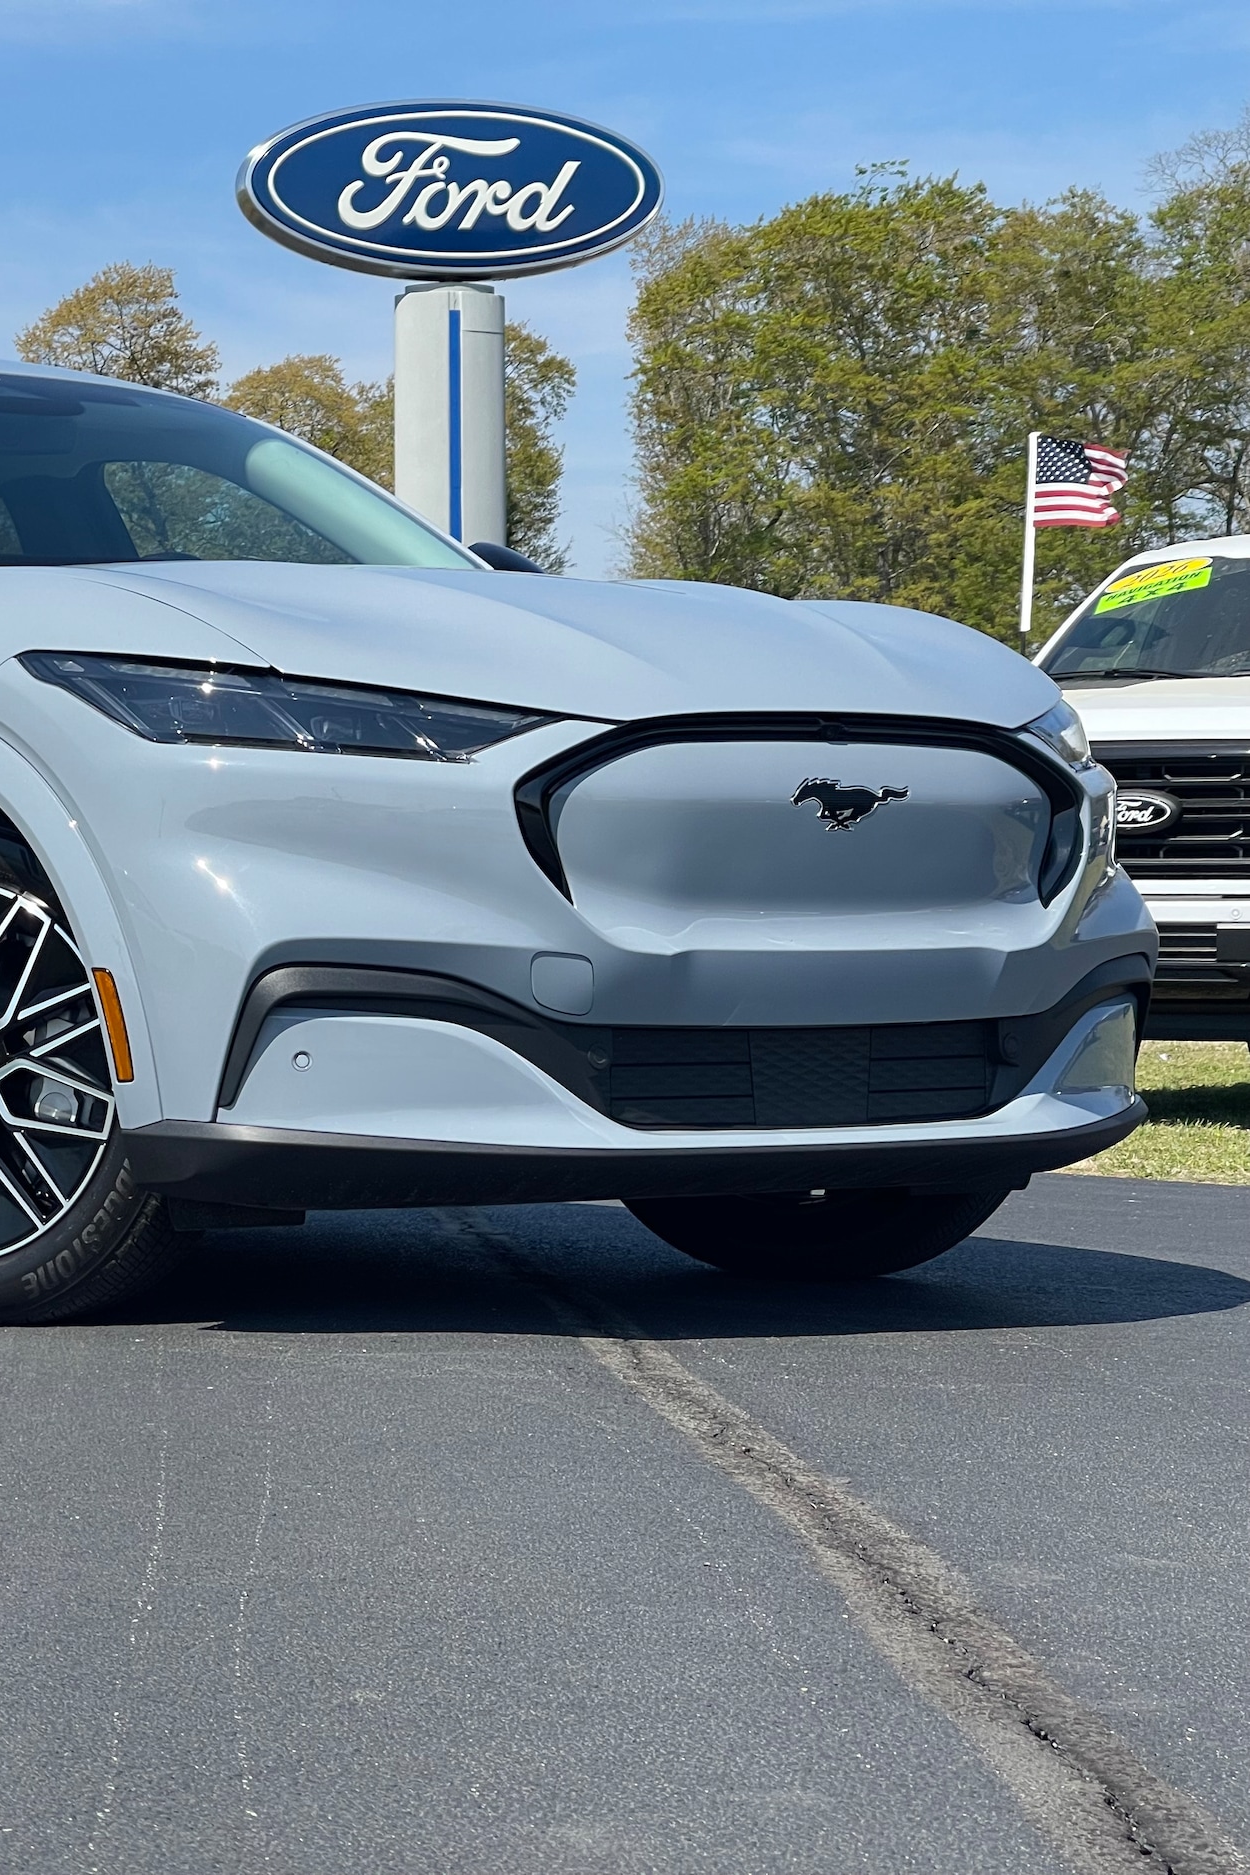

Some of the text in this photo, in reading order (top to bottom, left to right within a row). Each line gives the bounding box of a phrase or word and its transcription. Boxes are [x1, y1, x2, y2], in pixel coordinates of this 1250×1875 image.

[337, 131, 581, 232] Ford
[1105, 571, 1203, 602] NAVIGATION
[1119, 560, 1194, 589] 2026
[21, 1158, 133, 1299] DGESTONE
